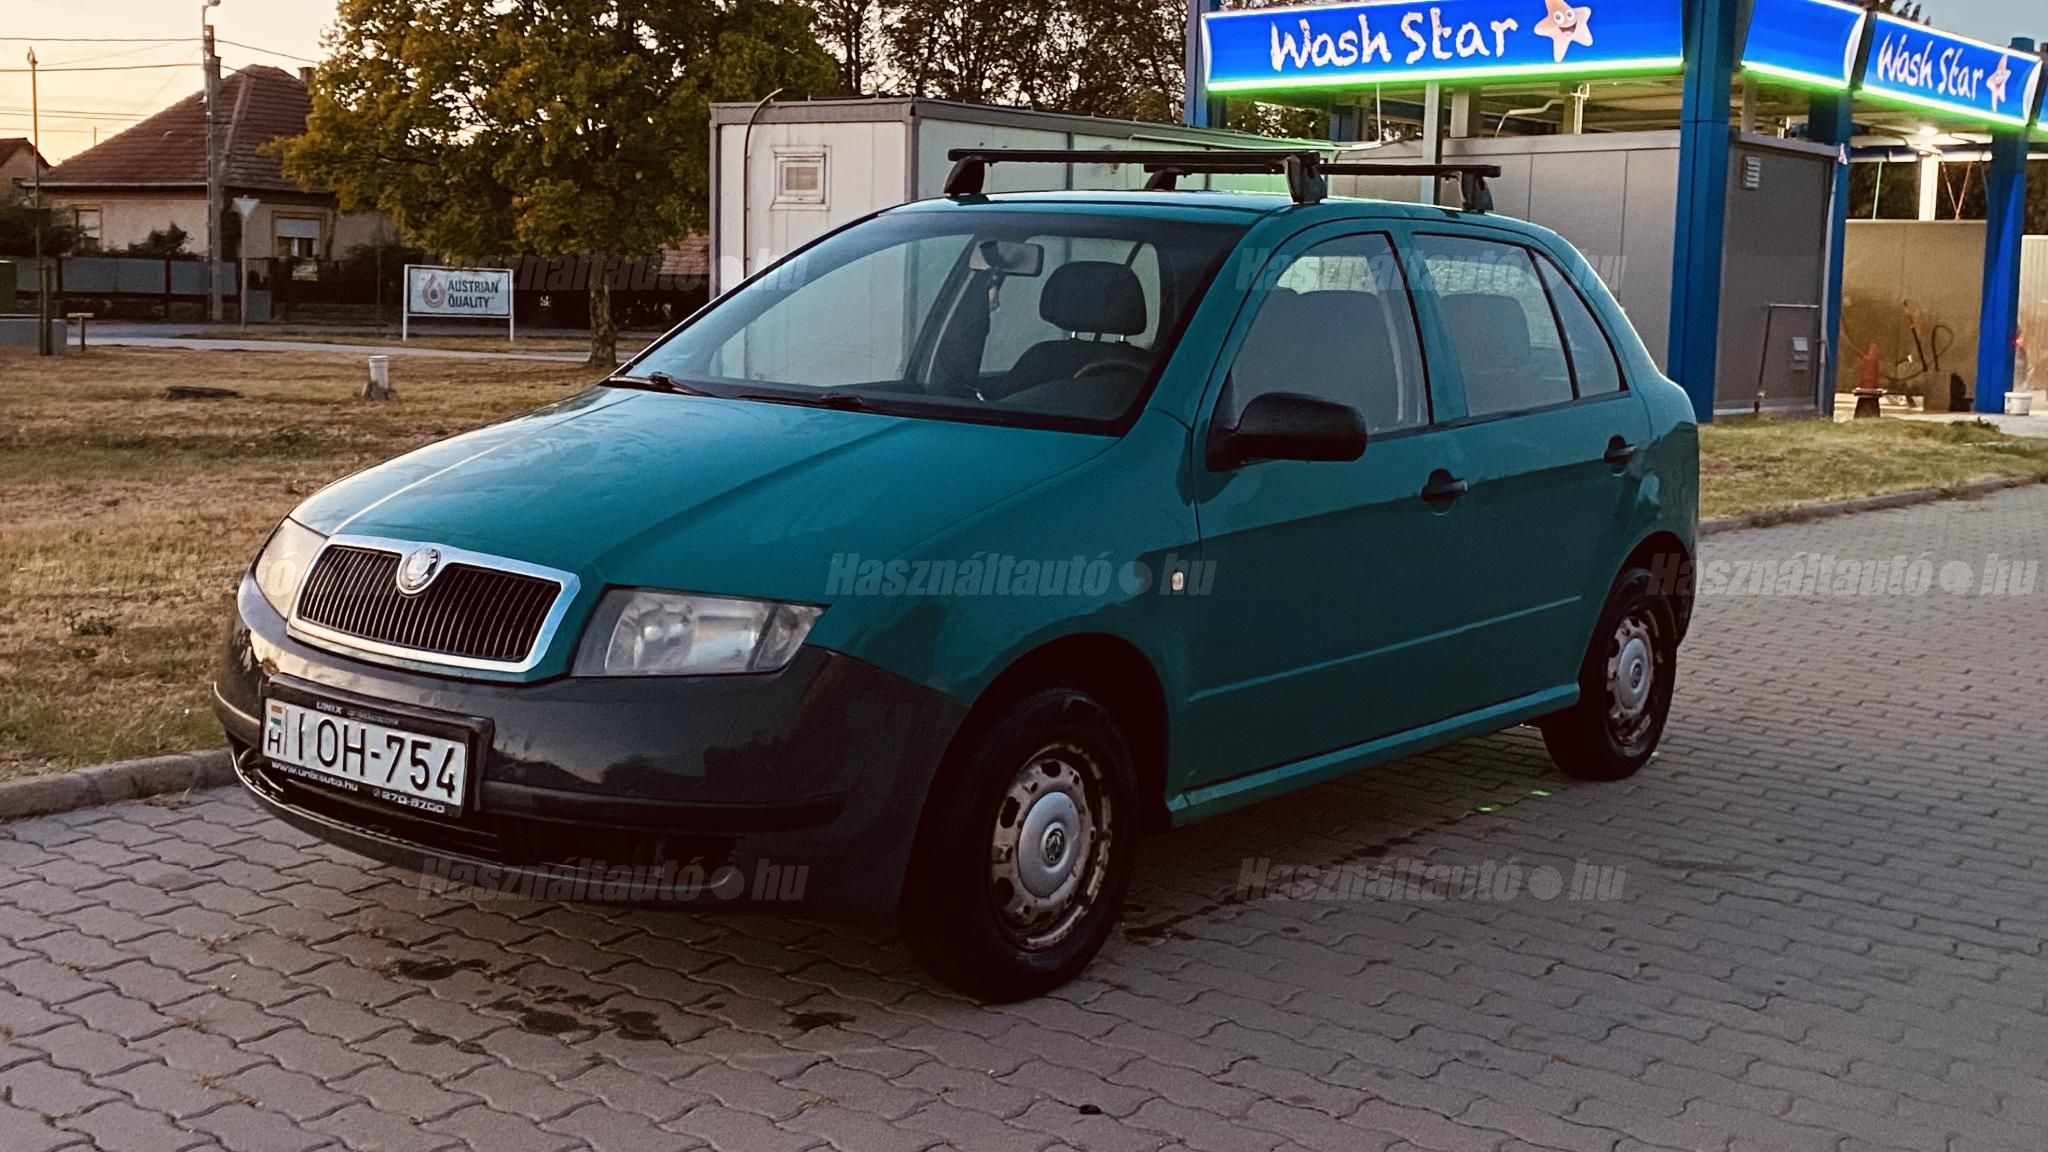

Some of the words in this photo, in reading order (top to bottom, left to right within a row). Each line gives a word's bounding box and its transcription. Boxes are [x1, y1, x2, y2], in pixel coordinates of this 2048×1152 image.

[1270, 14, 1392, 72] Wash
[1400, 8, 1519, 65] Star
[1877, 32, 1935, 90] Wash
[1937, 48, 1984, 101] Star
[447, 279, 500, 294] AUSTRIAN
[447, 293, 490, 309] QUALITY
[267, 729, 282, 755] H
